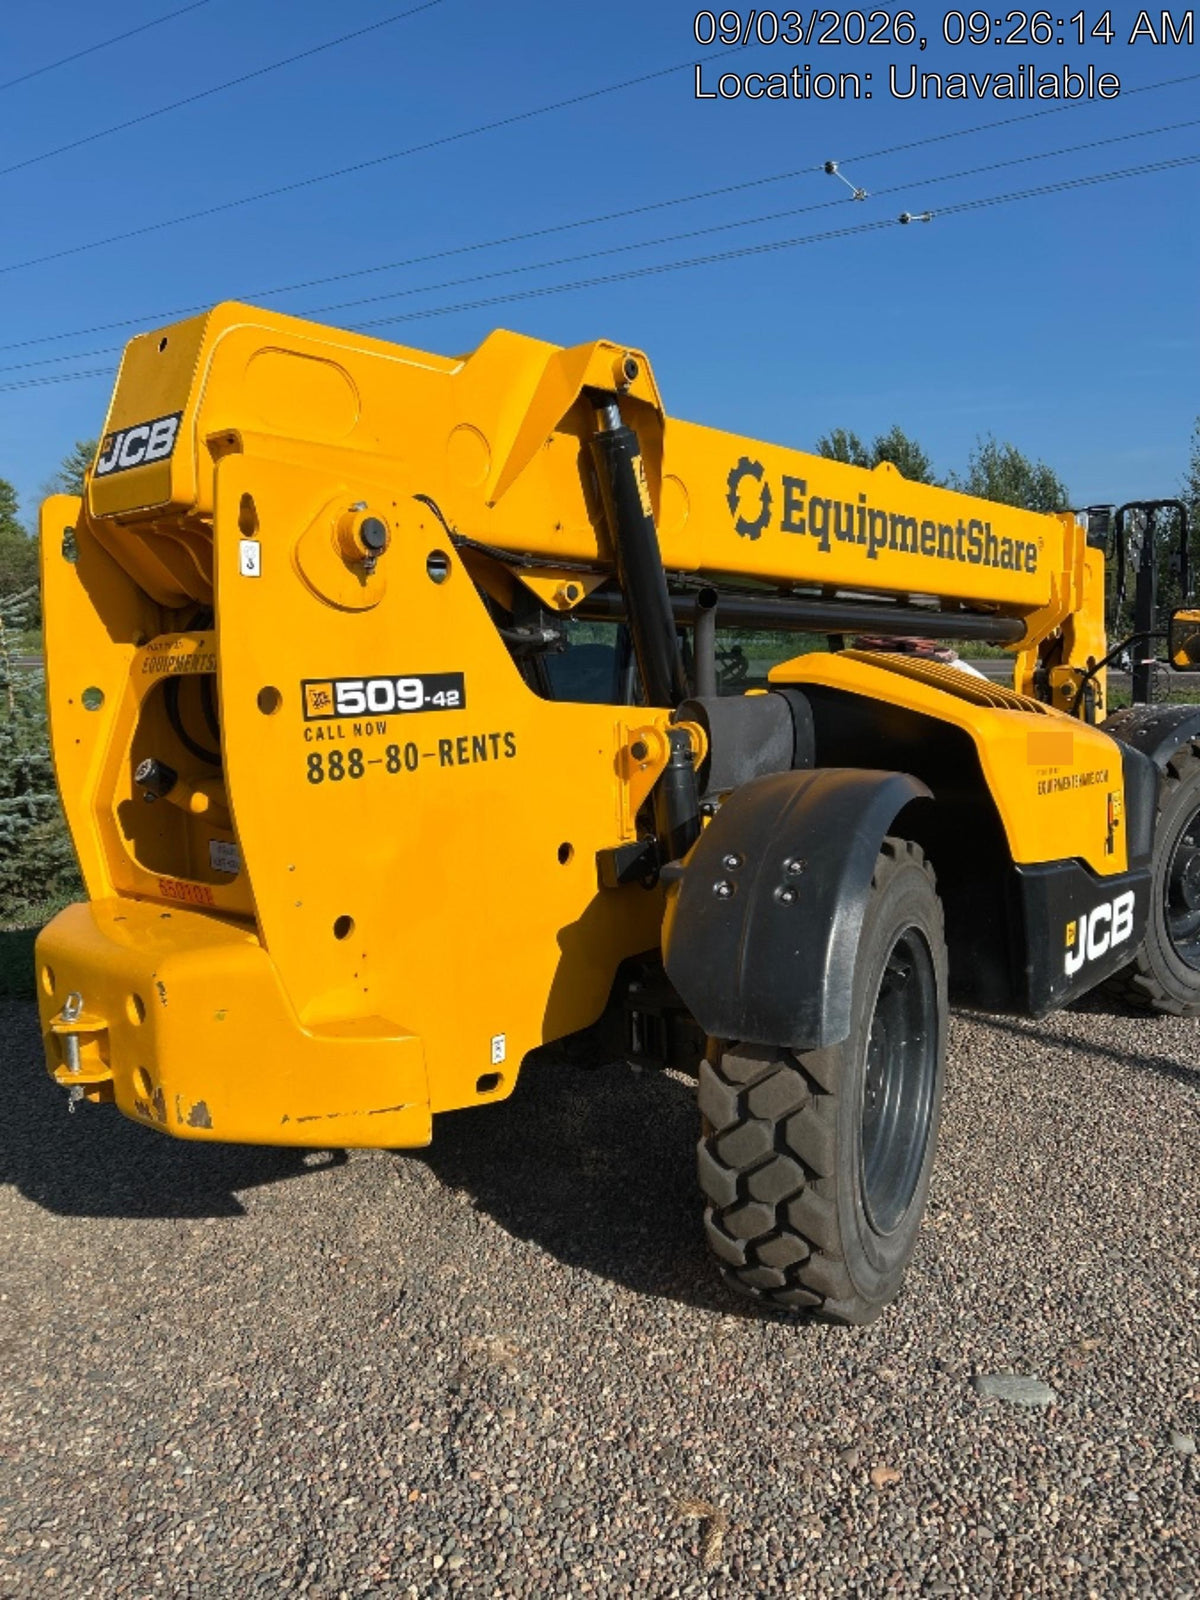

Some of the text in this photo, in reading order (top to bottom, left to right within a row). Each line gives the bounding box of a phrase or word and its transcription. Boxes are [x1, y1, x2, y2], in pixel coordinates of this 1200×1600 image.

[97, 416, 179, 475] JCB
[780, 474, 1038, 575] EquipmentShare
[303, 720, 387, 742] CALL NOW
[306, 731, 517, 785] 888-80-RENTS
[1064, 889, 1136, 977] JCB
